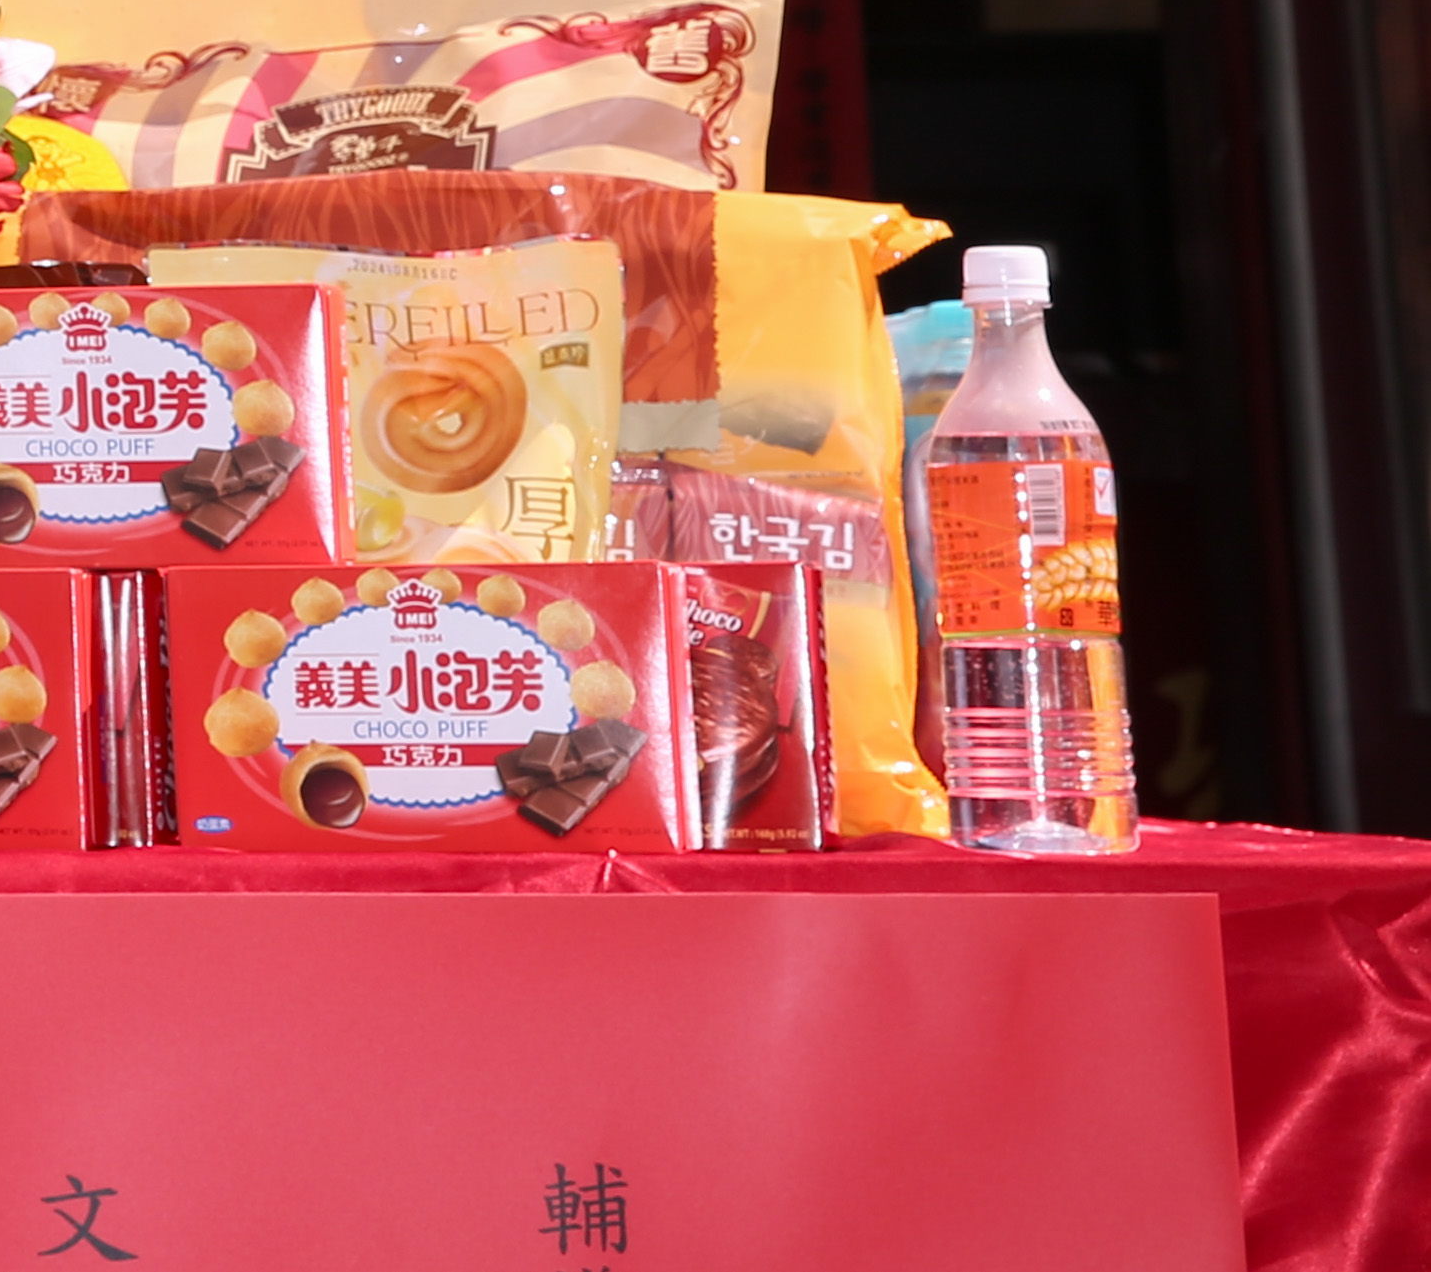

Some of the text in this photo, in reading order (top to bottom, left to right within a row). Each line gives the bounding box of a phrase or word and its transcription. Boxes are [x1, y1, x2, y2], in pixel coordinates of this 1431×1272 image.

[25, 438, 155, 457] CHOCO PUFF
[53, 463, 131, 483] 巧克力
[709, 511, 855, 571] 한국김
[353, 720, 489, 739] CHOCO PUFF
[381, 745, 464, 767] 巧克力
